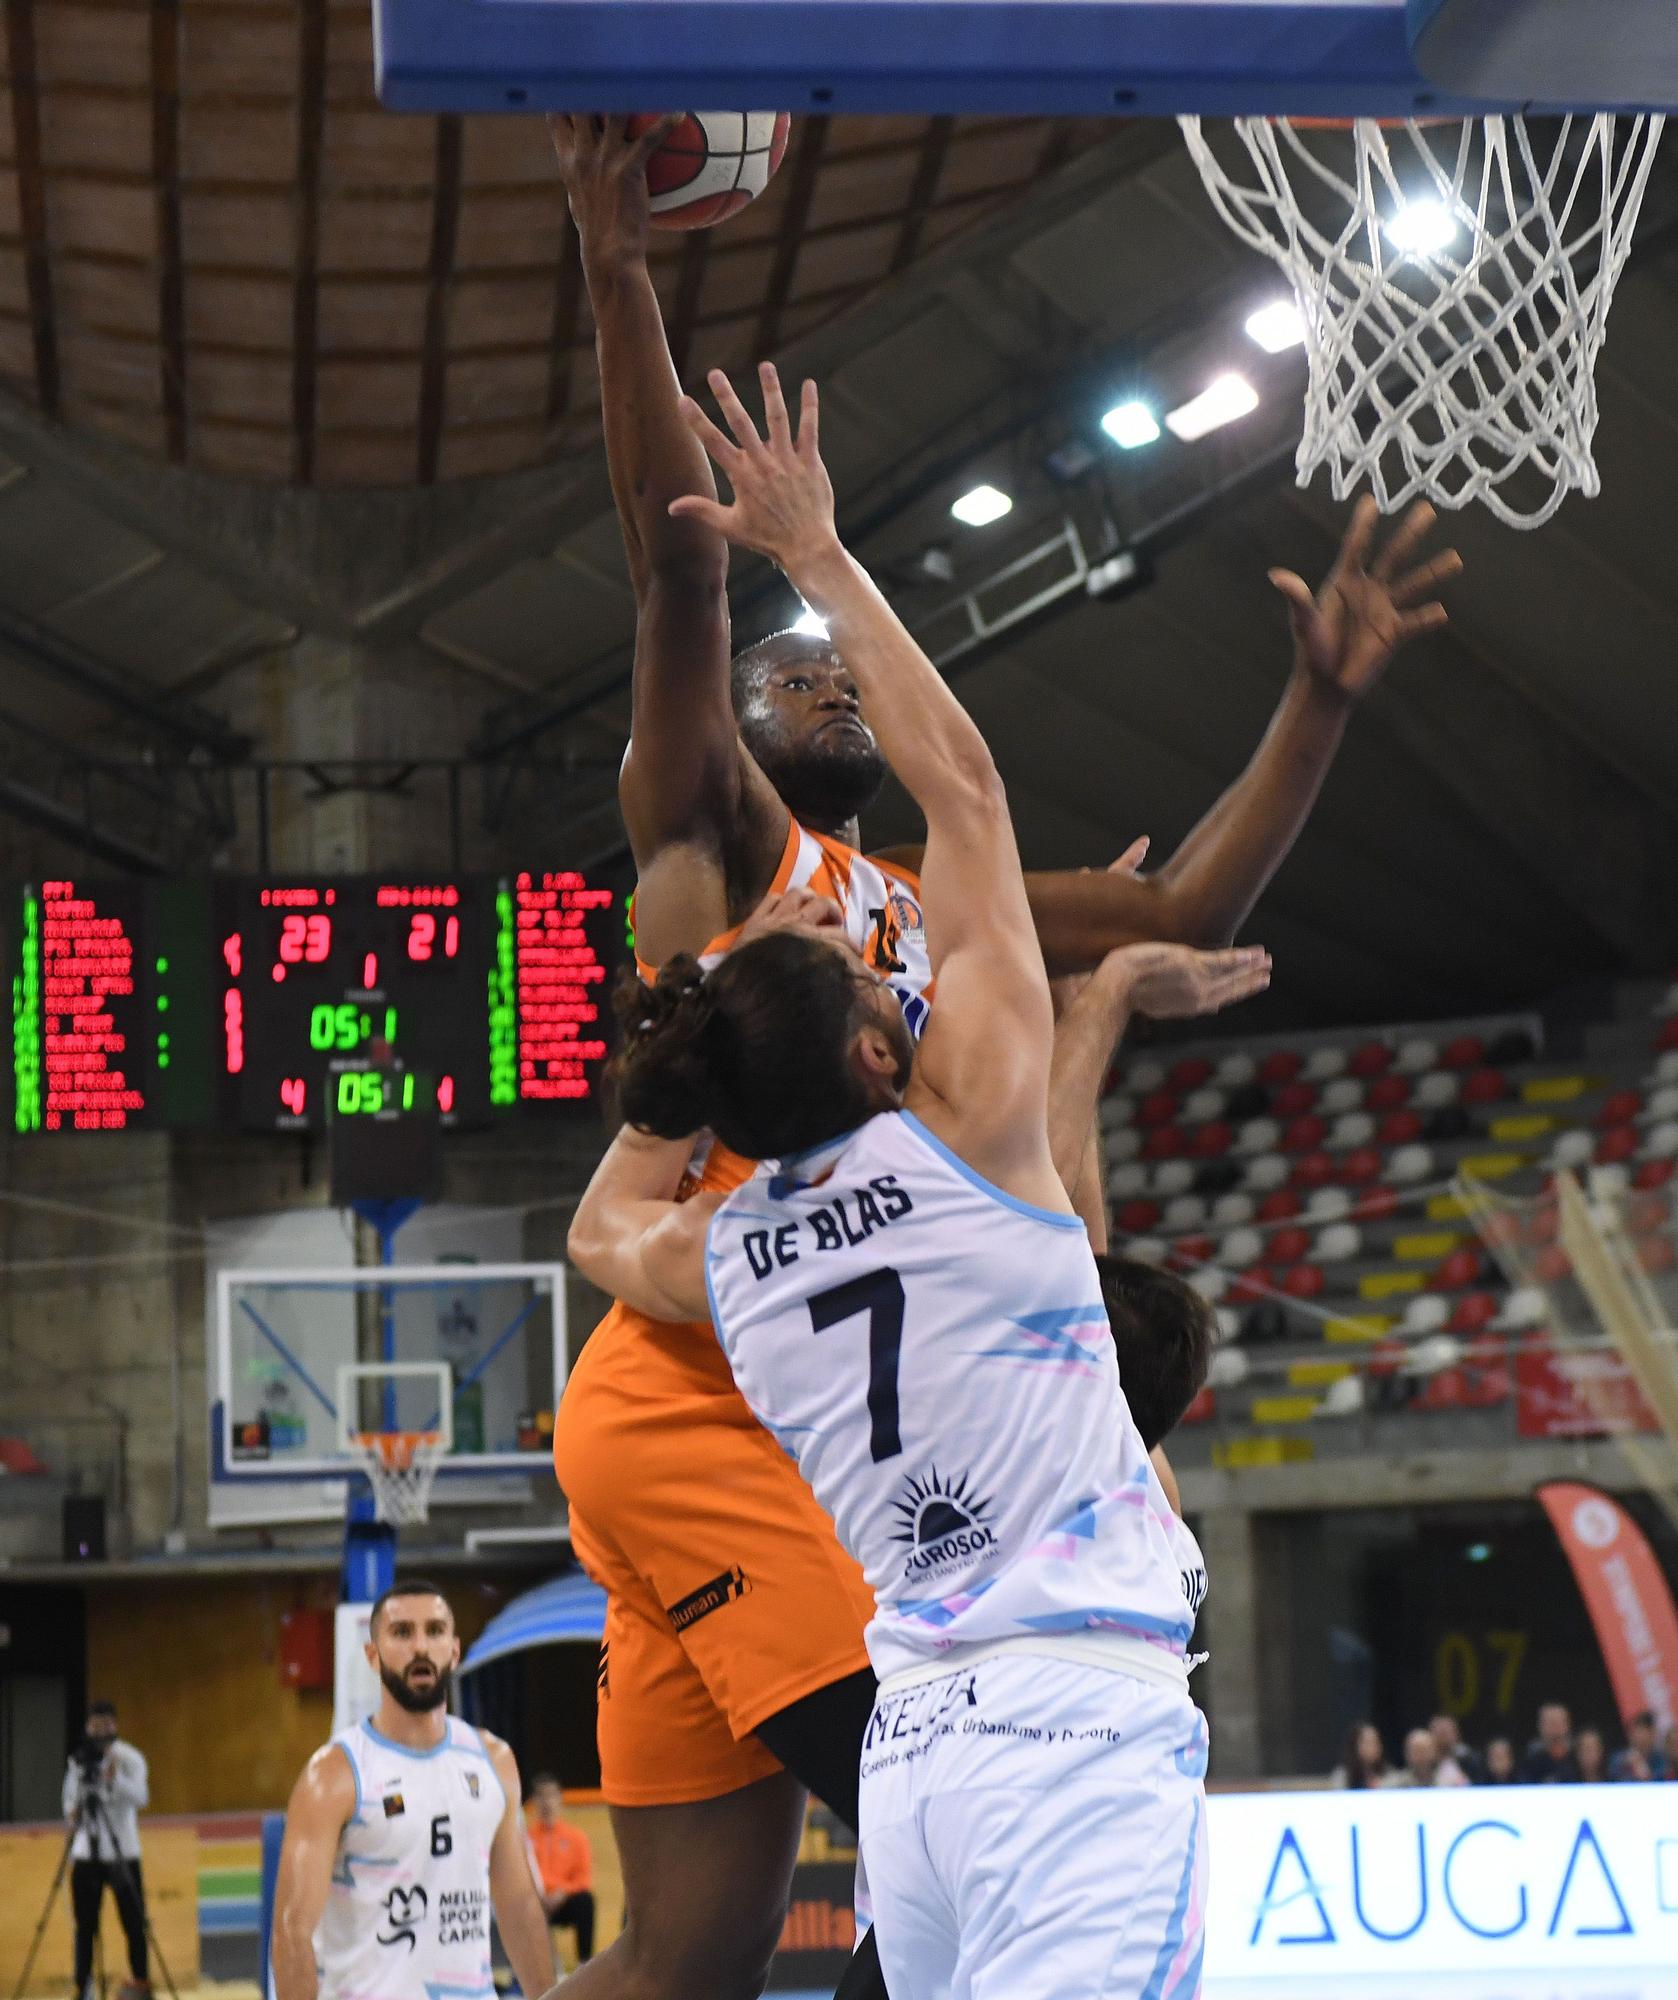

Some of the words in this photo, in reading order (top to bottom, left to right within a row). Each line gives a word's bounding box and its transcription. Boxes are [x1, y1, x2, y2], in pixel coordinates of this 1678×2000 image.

[279, 914, 332, 963] 23
[407, 912, 460, 961] 21
[743, 1222, 800, 1281] DE
[806, 1174, 914, 1251] BLAS
[806, 1266, 906, 1464] 7
[1436, 1631, 1527, 1716] 07
[430, 1814, 453, 1858] 6
[1250, 1818, 1637, 1946] AUGA
